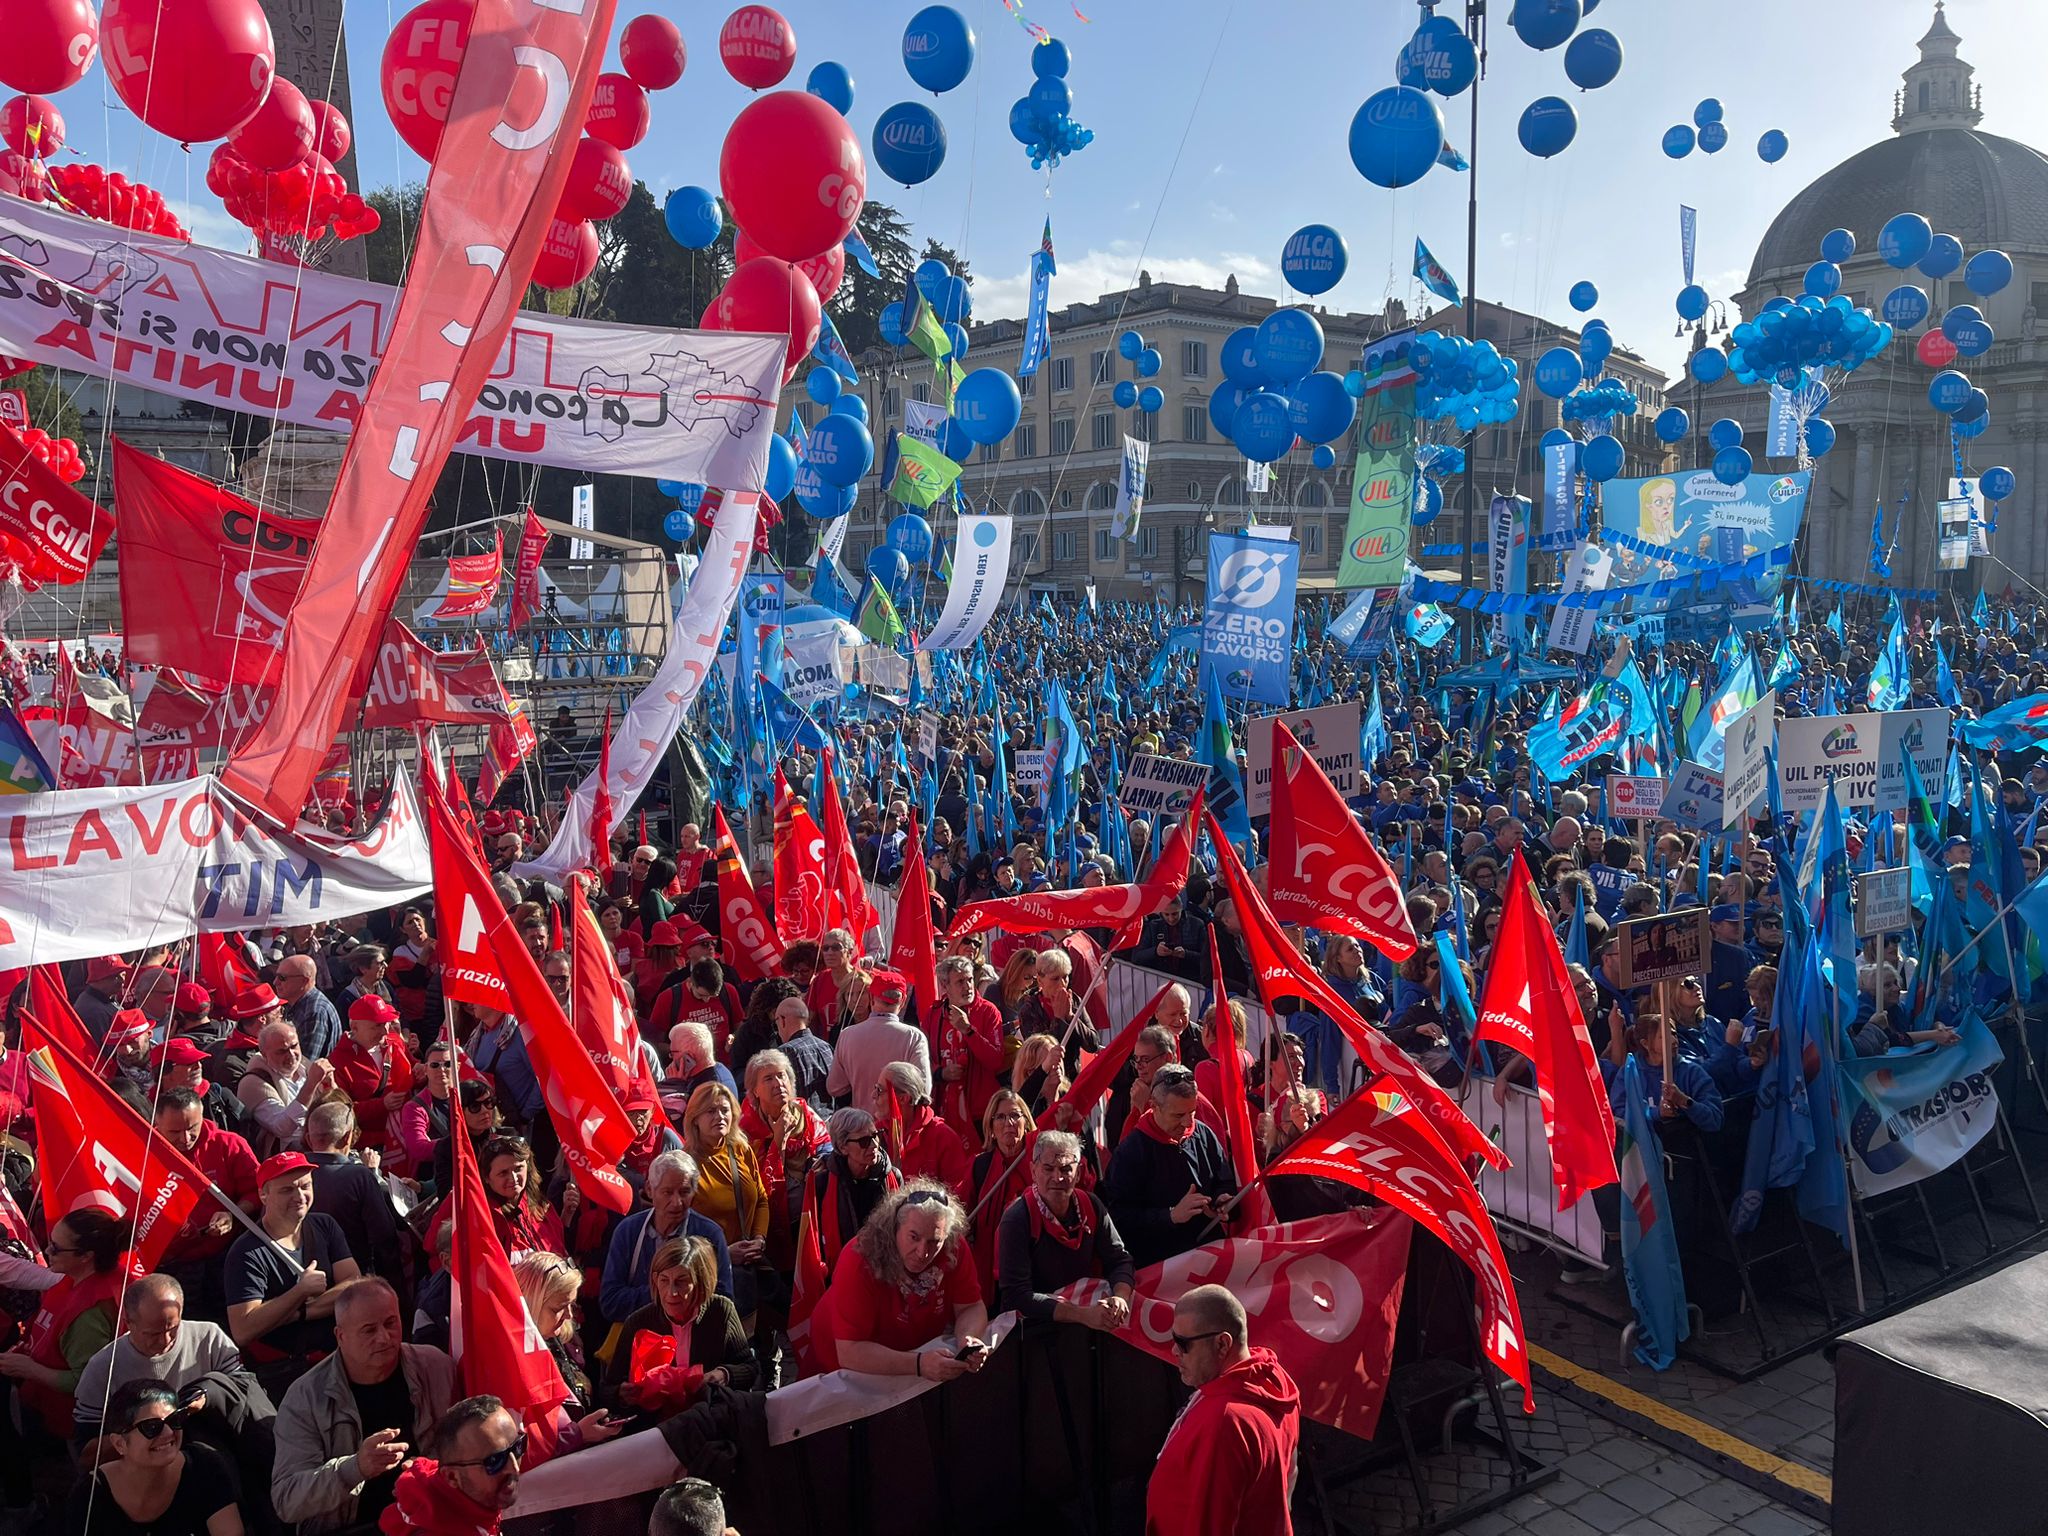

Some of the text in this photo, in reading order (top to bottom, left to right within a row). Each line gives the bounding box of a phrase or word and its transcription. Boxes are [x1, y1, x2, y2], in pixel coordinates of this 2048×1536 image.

[408, 20, 464, 57] FL
[101, 27, 149, 81] IL
[753, 43, 781, 61] LAZIO
[1425, 51, 1452, 69] UIL
[393, 75, 450, 120] CG
[592, 84, 615, 106] AMS
[1376, 101, 1418, 121] UILA
[889, 124, 926, 145] UILA
[600, 160, 631, 198] FILCT
[550, 218, 580, 248] TEM
[1285, 235, 1334, 258] UILCA
[1311, 260, 1333, 272] LAZIO
[1887, 298, 1920, 312] UIL
[1888, 310, 1920, 320] LAZIO
[1957, 330, 1977, 341] UIL
[1539, 368, 1570, 382] UIL
[1365, 475, 1399, 501] UILA
[1691, 477, 1721, 488] Cambie
[1703, 487, 1737, 498] Fornero!
[671, 515, 693, 525] UIL
[1726, 512, 1767, 528] in peggio!
[29, 500, 90, 563] CGIL
[896, 528, 927, 545] UIL
[895, 542, 925, 551] POSTI
[1356, 532, 1392, 558] UILA
[756, 598, 780, 611] UIL
[1204, 609, 1286, 639] ZERO
[1204, 629, 1285, 651] MORTI SUL
[1203, 640, 1284, 664] LAVORO
[1236, 676, 1256, 688] UIL
[1835, 738, 1858, 751] UIL
[1910, 734, 1923, 746] UIL
[1016, 753, 1045, 766] UIL PENSI
[1319, 752, 1354, 772] ONATI
[1017, 769, 1042, 780] COR
[1132, 757, 1207, 789] UIL PENSIONATI
[1691, 770, 1705, 780] UIL
[1727, 757, 1769, 800] CAMERA SINDACAL
[1785, 761, 1876, 781] UIL PENSION
[1882, 764, 1896, 779] UIL
[1616, 788, 1634, 797] STOP
[1633, 779, 1662, 788] PRECARIATO
[1683, 778, 1724, 803] LAZ
[1848, 780, 1877, 798] IVO
[1921, 779, 1941, 797] VOLI
[1122, 786, 1164, 809] LATINA
[1635, 797, 1661, 806] DI RICERCA
[1735, 795, 1743, 810] DI
[1616, 807, 1659, 816] ADESSO BAST
[199, 858, 324, 919] TIM
[1319, 901, 1344, 920] della
[1888, 912, 1906, 927] BASTA
[726, 896, 784, 977] CGIL
[896, 944, 916, 958] Fed
[688, 1007, 712, 1018] FEDELI
[697, 1011, 720, 1023] IDEALI
[1481, 1009, 1534, 1044] Federaz
[1429, 1101, 1470, 1125] Cono
[1278, 1157, 1363, 1175] Federazione
[1364, 1172, 1437, 1217] Lavoratori
[1320, 1131, 1520, 1360] FLC CGIL
